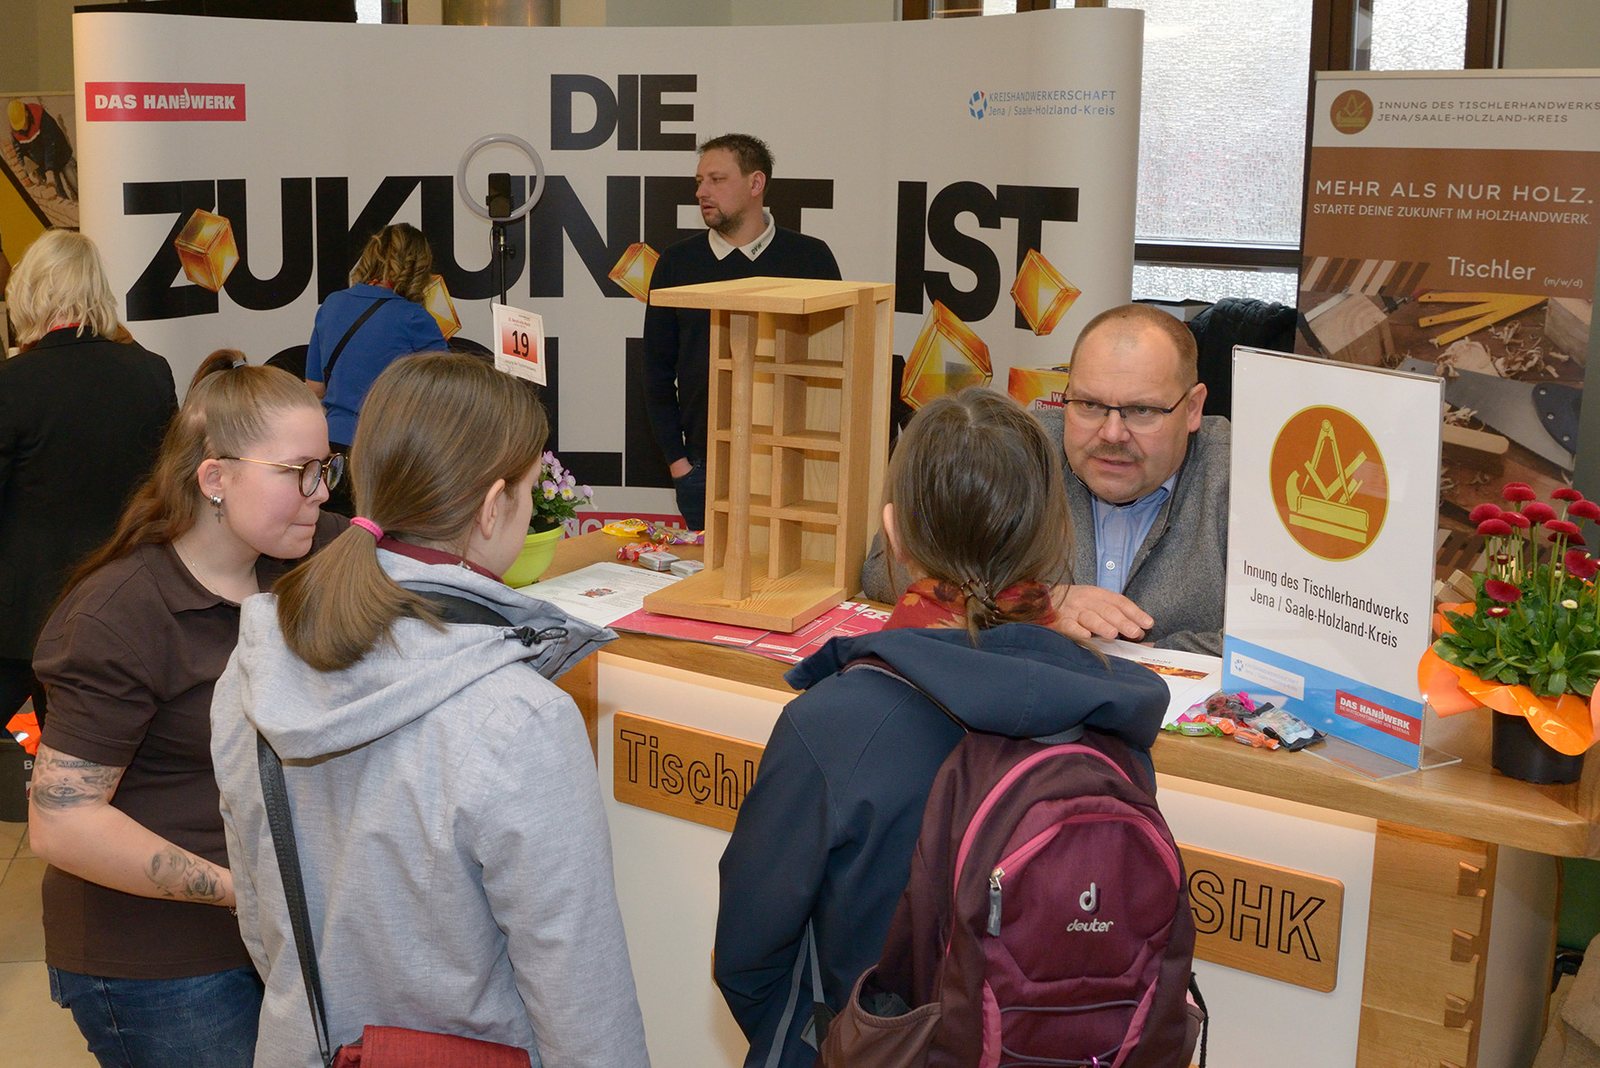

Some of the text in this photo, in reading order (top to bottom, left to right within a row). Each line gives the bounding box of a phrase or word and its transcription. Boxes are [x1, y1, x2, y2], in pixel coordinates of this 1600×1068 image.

[94, 90, 236, 110] DAS HANDWERK
[989, 90, 1117, 103] KREISHANDWERKERSCHAFT
[1378, 101, 1600, 111] INNUNG DES TISCHLERHANDWERKS
[549, 73, 697, 151] DIE
[988, 105, 1006, 117] Jena
[1014, 104, 1116, 117] Saale-Holzland-Kreis
[1377, 113, 1569, 124] JENA/SAALE-HOLZLAND-KREIS
[1315, 180, 1594, 204] MEHR ALS NUR HOLZ.
[1313, 203, 1593, 226] STARTE DEINE ZUKUNFT IM HOLZHANDWERK.
[894, 180, 1080, 331] IST
[1447, 255, 1584, 289] Tischler (m/w/d)
[512, 329, 530, 358] 19
[1243, 560, 1410, 625] Innung des Tischlerhandwerks
[1250, 587, 1275, 609] Jena
[1284, 598, 1399, 648] Saale-Holzland-Kreis
[1340, 697, 1411, 731] DAS HANDWERK
[1066, 918, 1114, 933] deuter
[1188, 869, 1326, 963] SHK
